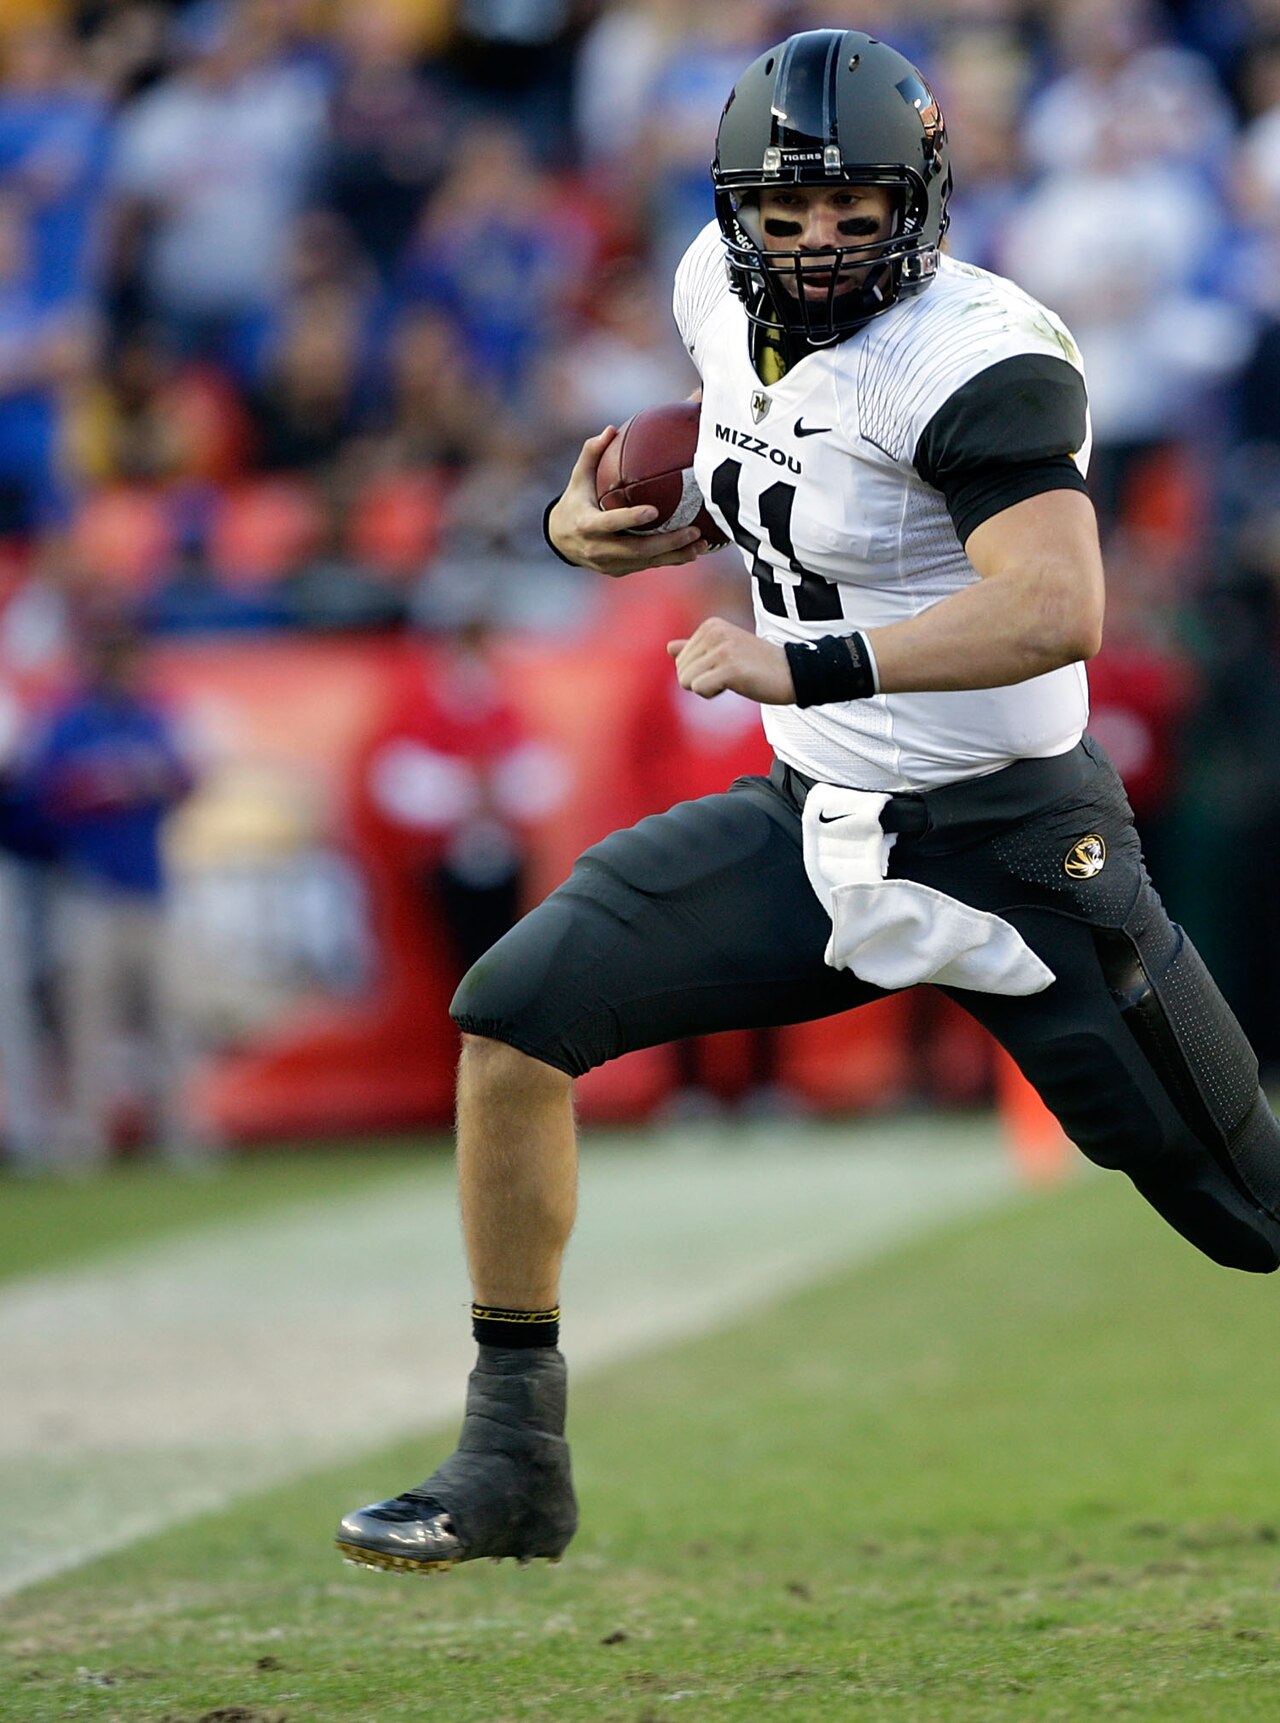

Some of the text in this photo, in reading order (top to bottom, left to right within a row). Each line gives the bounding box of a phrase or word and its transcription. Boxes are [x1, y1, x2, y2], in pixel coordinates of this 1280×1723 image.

[782, 153, 822, 161] TIGERS
[715, 423, 801, 475] MIZZOU
[711, 457, 844, 621] 11
